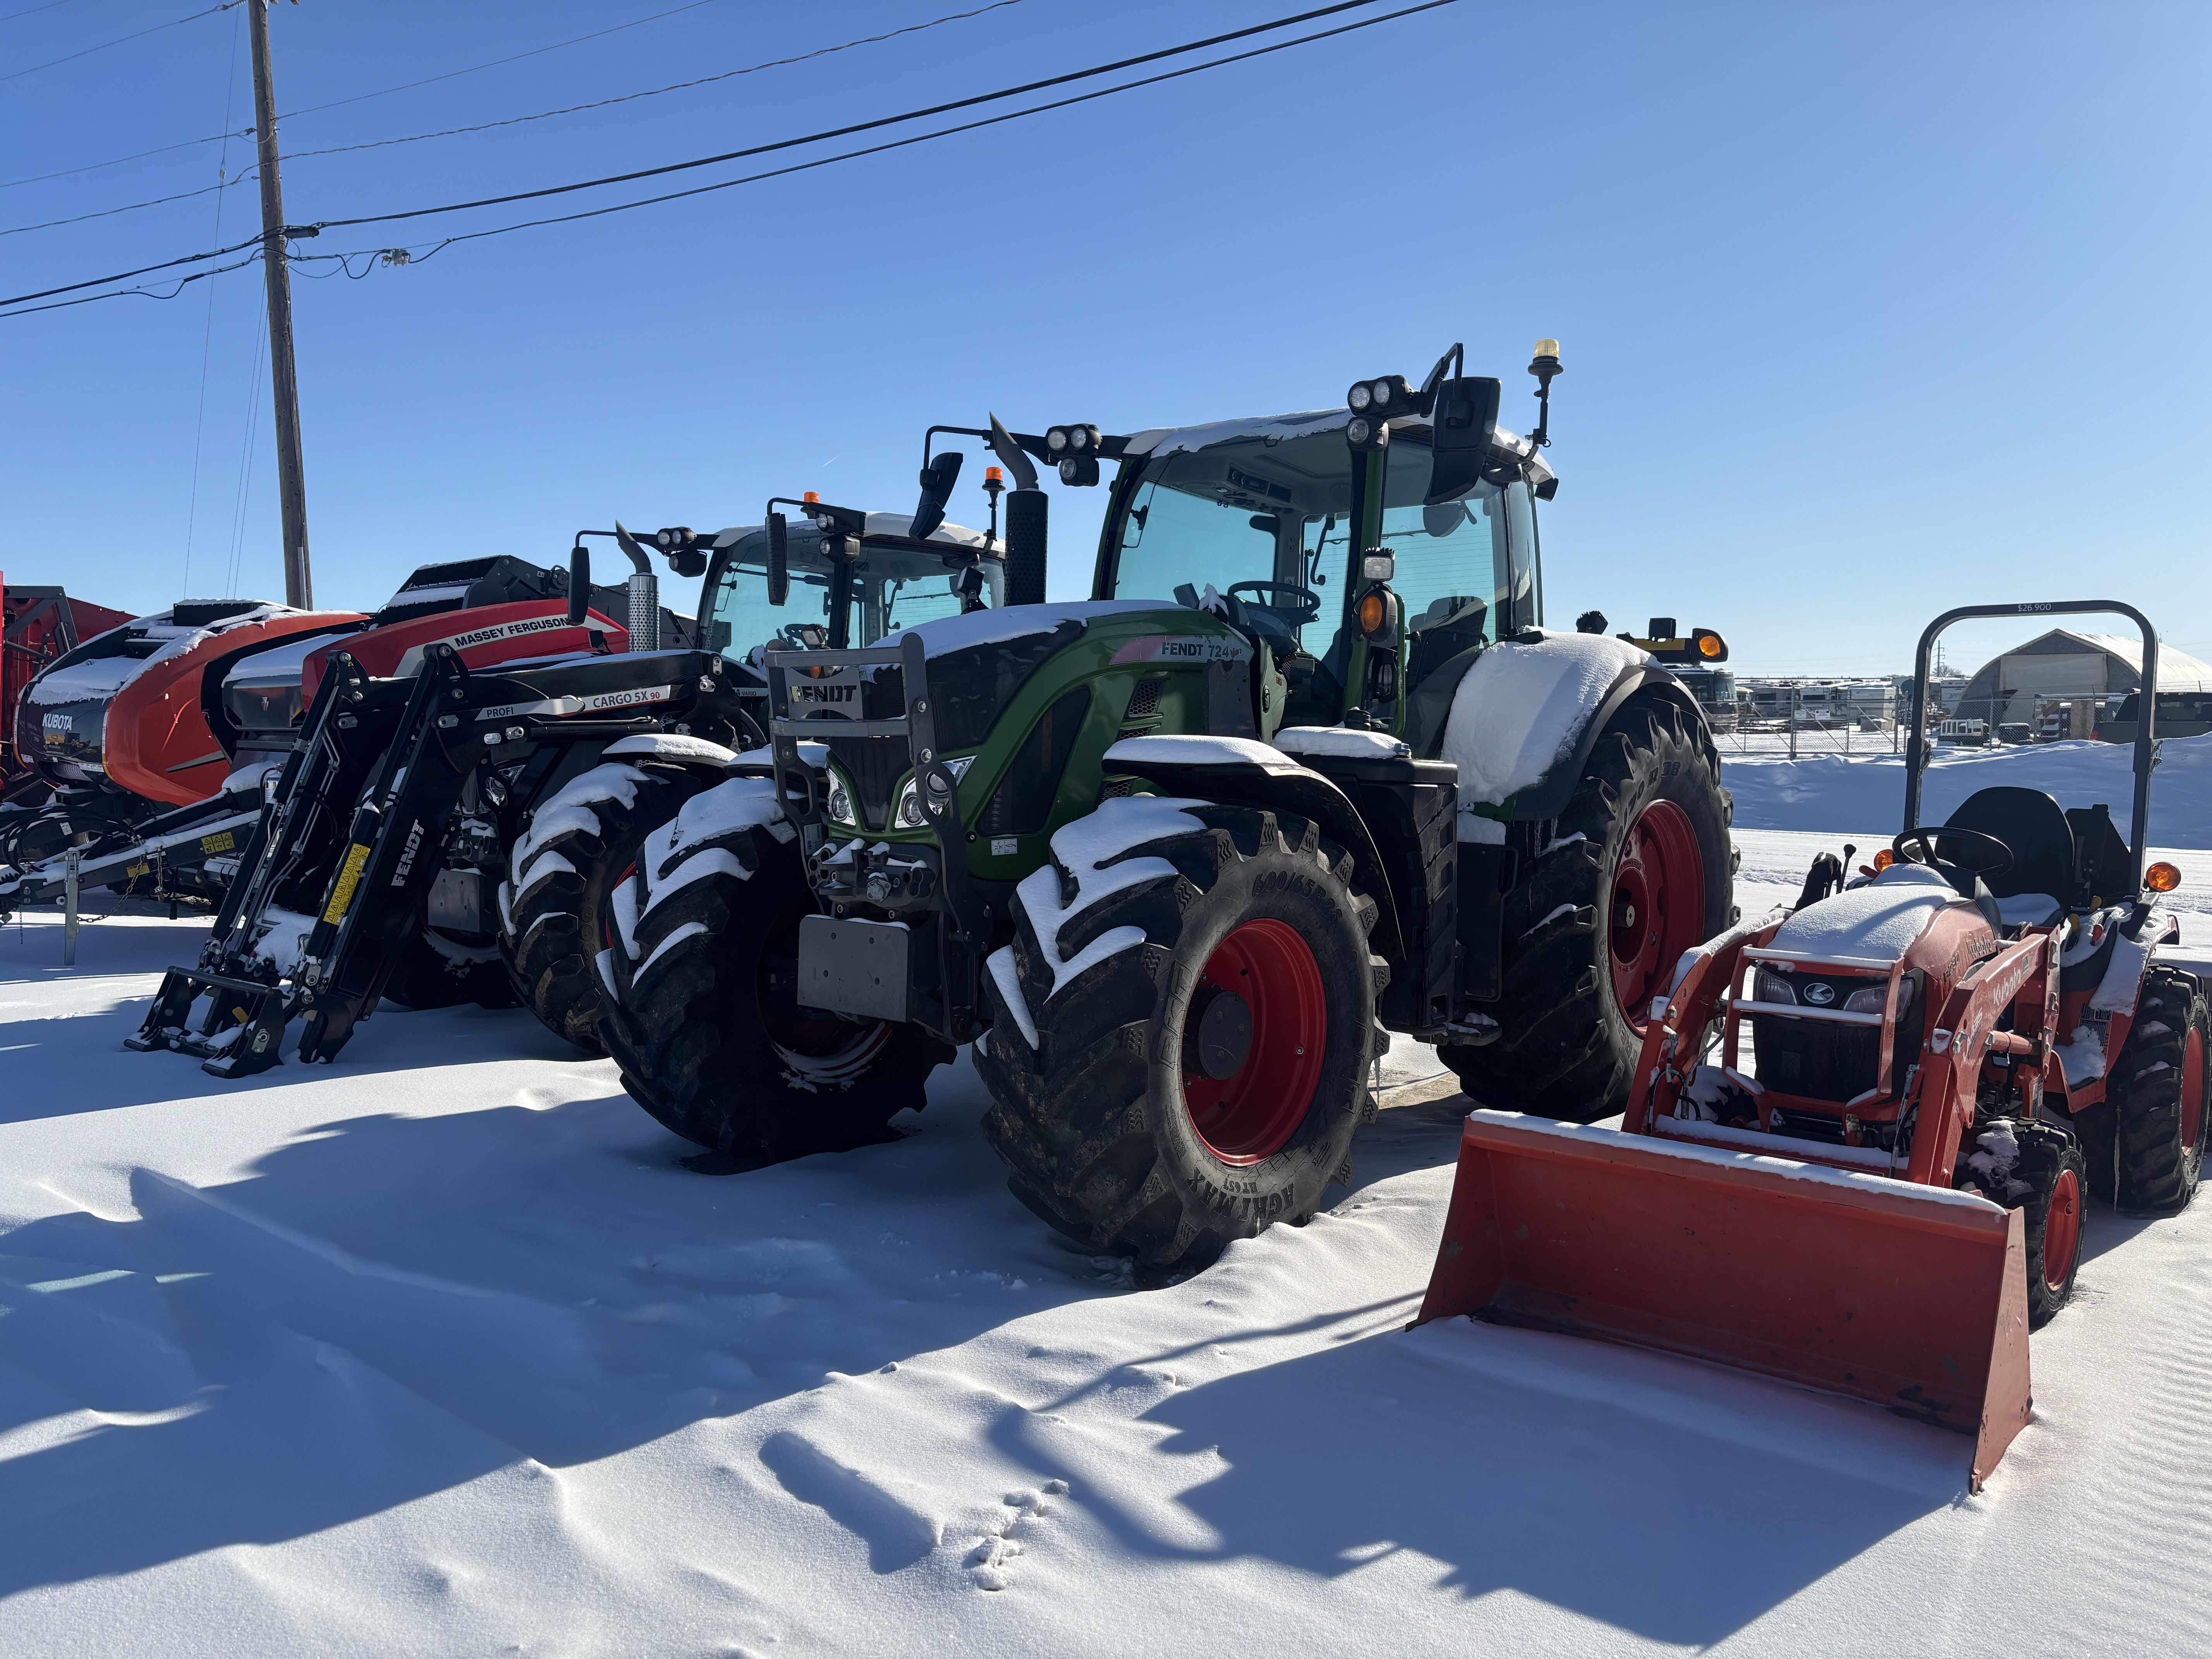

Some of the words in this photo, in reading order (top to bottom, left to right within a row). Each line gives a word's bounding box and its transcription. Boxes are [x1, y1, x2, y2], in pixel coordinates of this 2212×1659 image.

[455, 627, 504, 647] MASSEY
[507, 617, 569, 634] FERGUSON
[1162, 642, 1203, 657] FENDT
[1209, 645, 1229, 658] 724
[592, 694, 632, 708] CARGO
[635, 691, 649, 702] 5X
[650, 692, 661, 700] 90
[791, 685, 857, 702] FENDT
[487, 707, 514, 718] PROFI
[42, 713, 72, 730] KUBOTA
[392, 819, 425, 886] FENDT
[1966, 935, 1992, 959] Kubota
[1994, 967, 2021, 1006] Kubota
